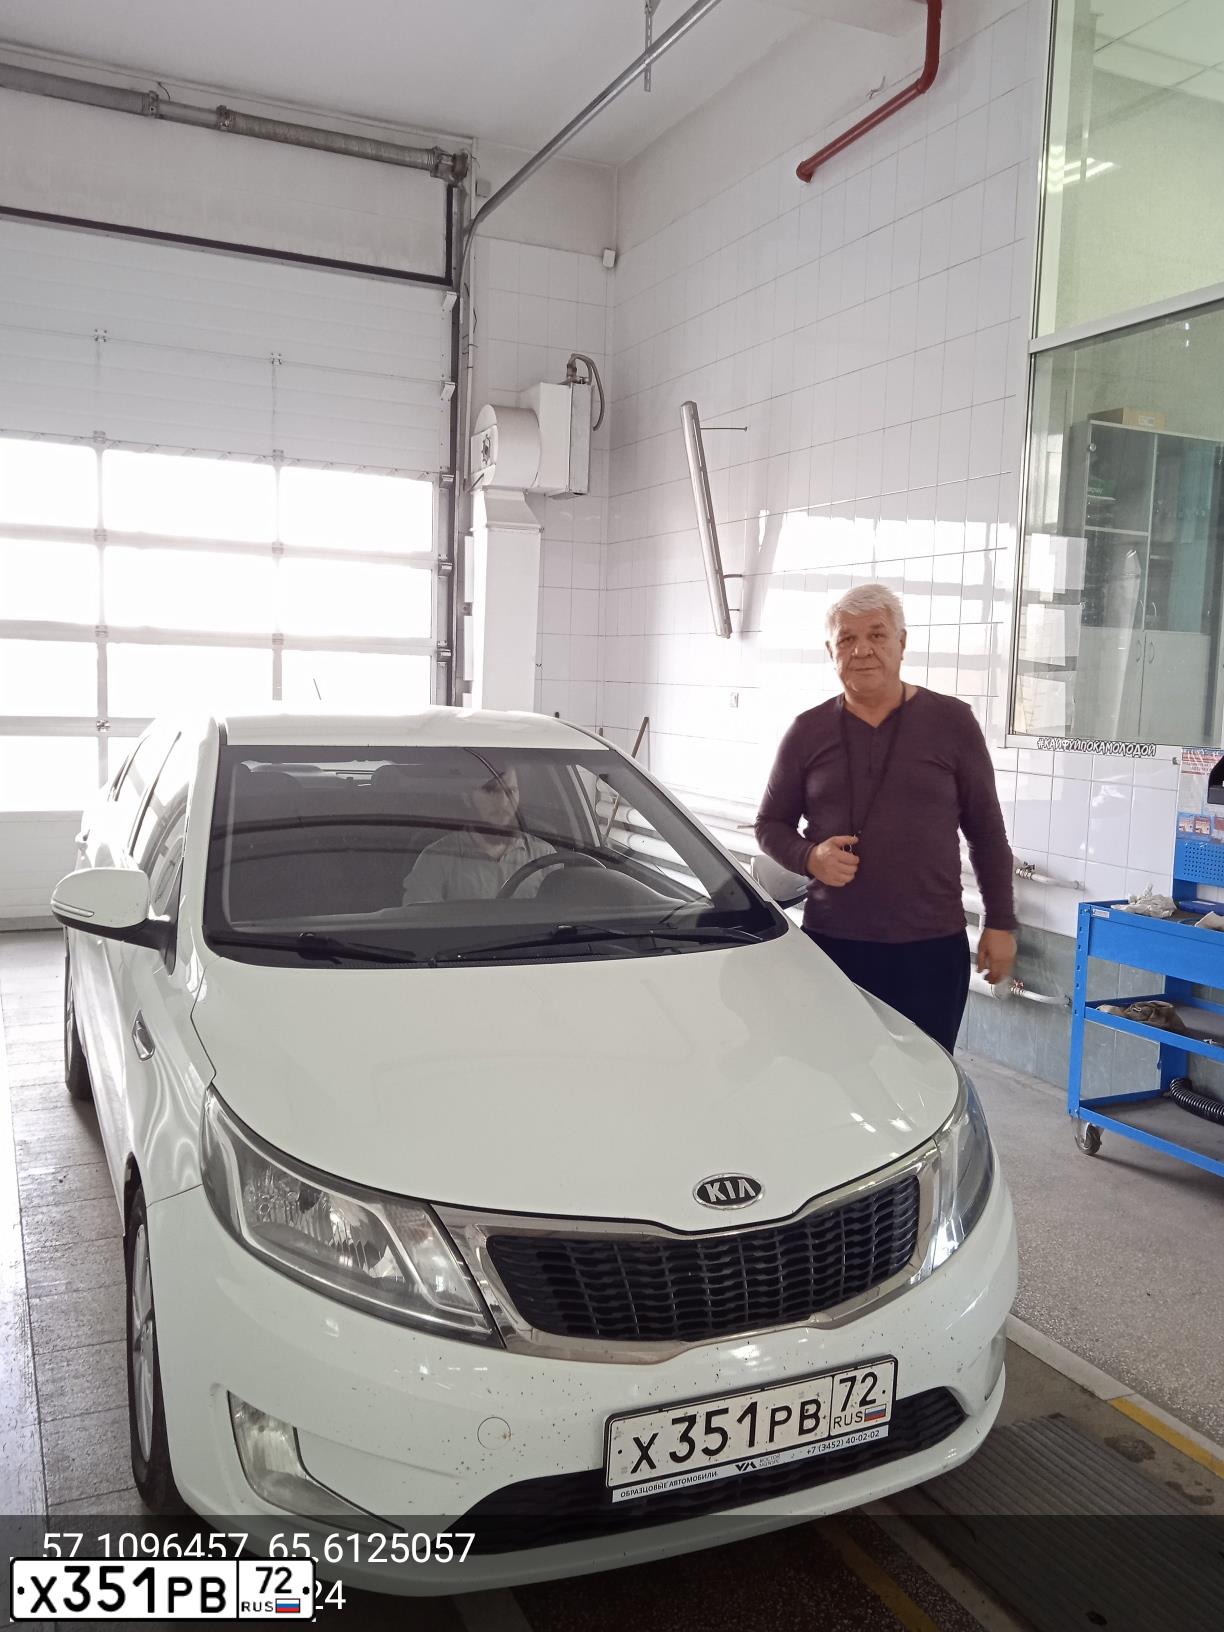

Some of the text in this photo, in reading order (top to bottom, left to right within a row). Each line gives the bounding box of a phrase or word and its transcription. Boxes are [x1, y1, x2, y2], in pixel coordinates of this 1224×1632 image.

[704, 1179, 756, 1201] KIA
[839, 1371, 877, 1412] 72
[833, 1410, 863, 1430] RUS
[806, 1430, 880, 1455] +7 (3452) 40-02-02
[620, 1471, 718, 1498] ОБРАЗЦОВЫЕ АВТОМОБИЛИ
